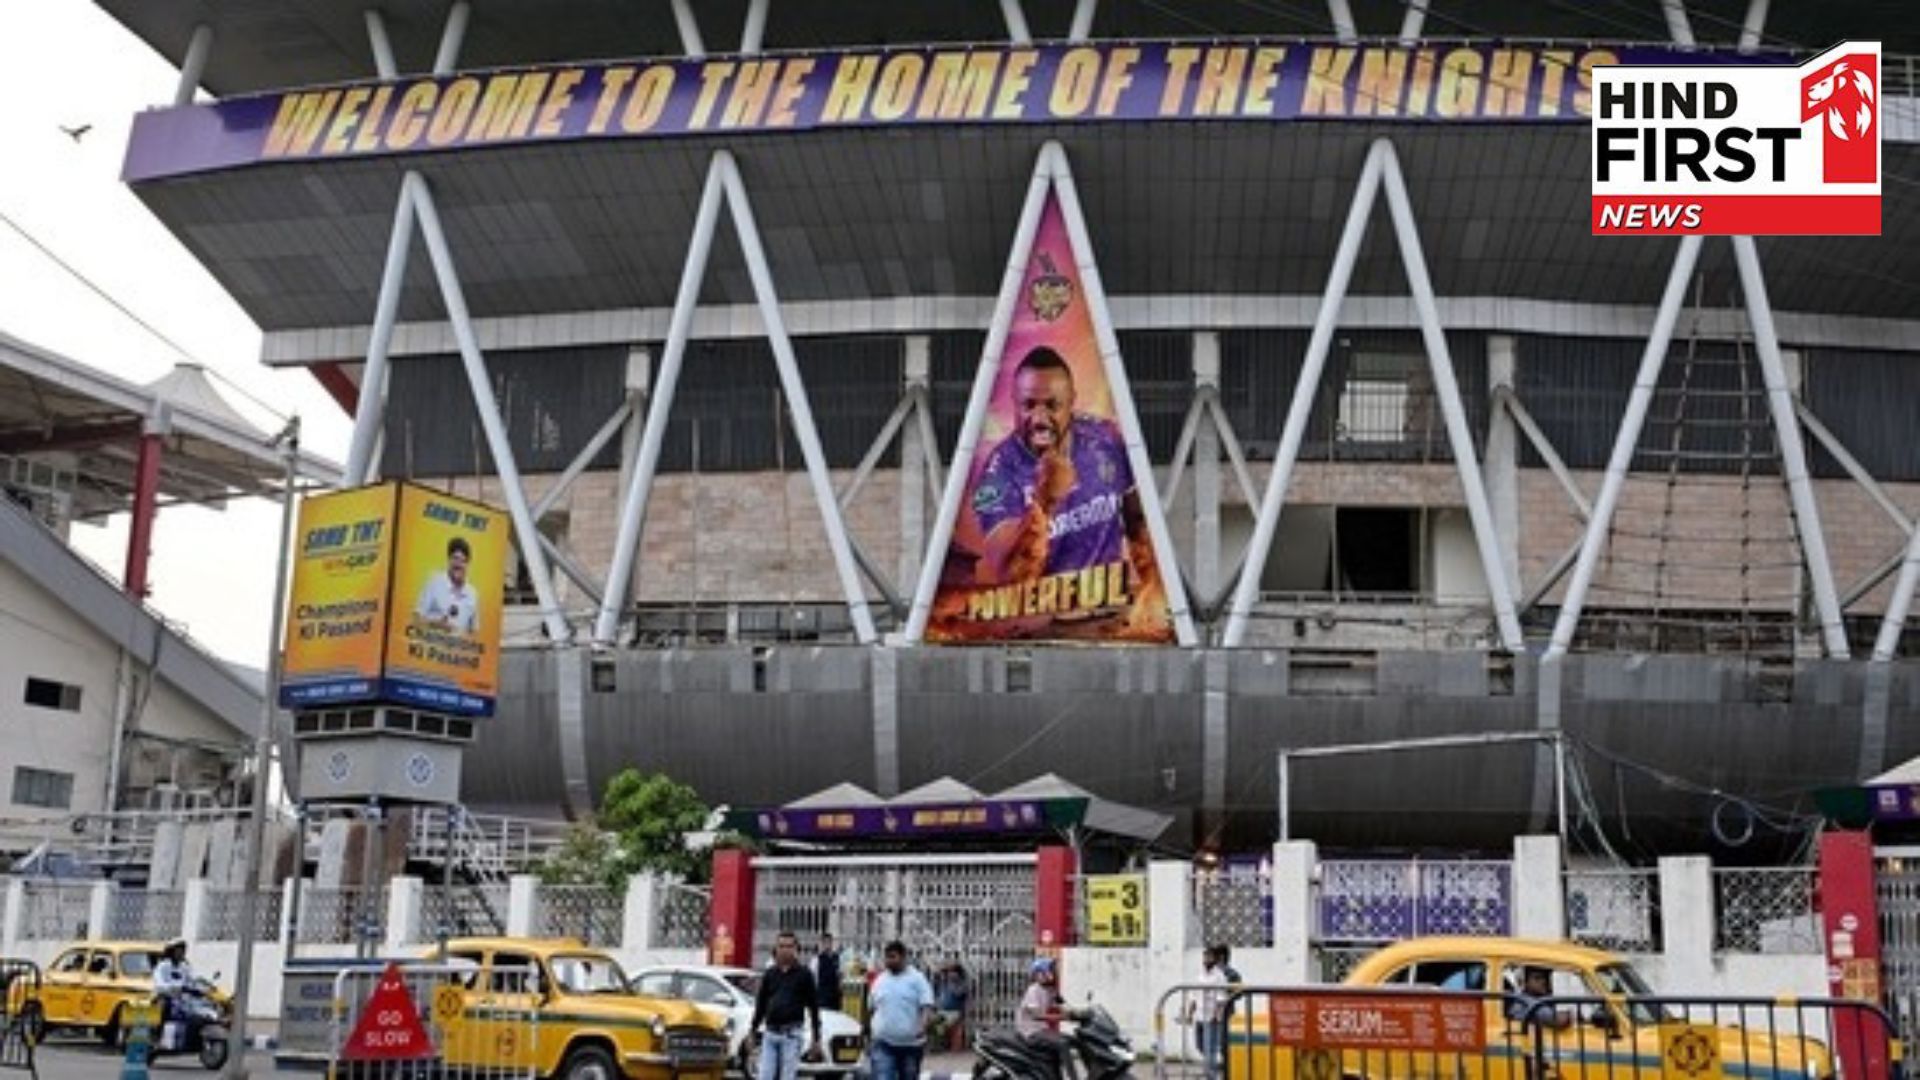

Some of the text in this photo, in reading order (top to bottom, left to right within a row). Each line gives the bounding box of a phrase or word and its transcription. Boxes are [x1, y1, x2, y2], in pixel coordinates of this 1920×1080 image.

[261, 69, 585, 157] WELCOME
[586, 65, 676, 133] TO
[688, 58, 816, 130] THE
[819, 51, 1039, 122] HOME
[1048, 48, 1140, 118] OF
[1158, 47, 1286, 117] THE
[968, 561, 1130, 620] POWERFUL
[1122, 881, 1139, 910] 3
[377, 1010, 403, 1026] GO
[1317, 1010, 1382, 1035] SERUM
[365, 1030, 412, 1047] SLOW
